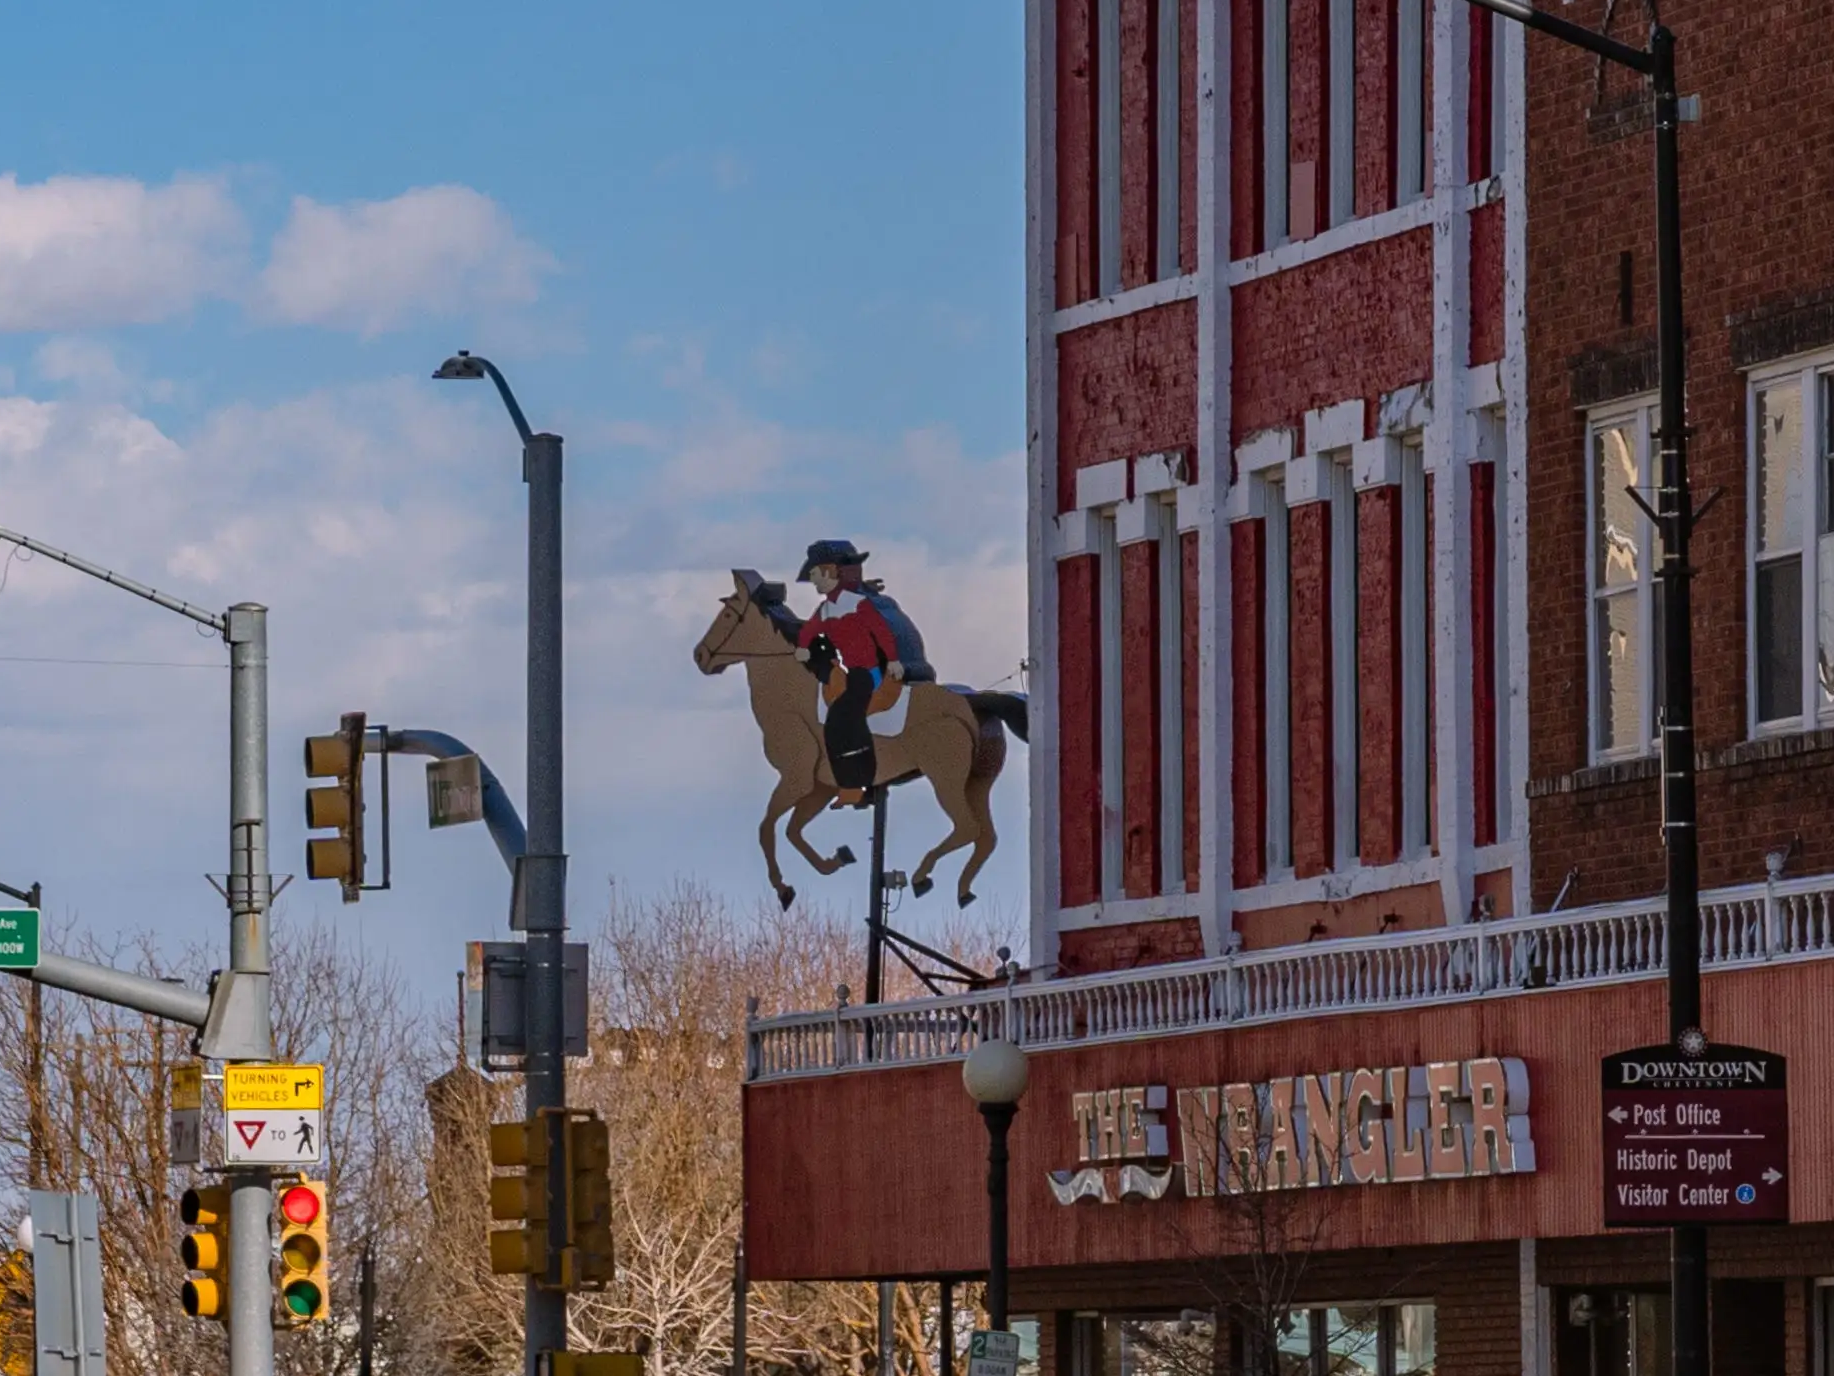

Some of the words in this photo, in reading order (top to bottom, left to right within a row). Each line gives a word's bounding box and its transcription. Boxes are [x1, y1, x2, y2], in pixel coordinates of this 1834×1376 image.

[232, 1072, 288, 1085] TURNING
[1620, 1060, 1768, 1084] DOWNTOWN
[1652, 1080, 1734, 1088] CHEYENNE
[230, 1090, 290, 1103] VEHICLES
[1633, 1103, 1668, 1126] Post
[1675, 1103, 1722, 1126] Office
[270, 1129, 287, 1141] TO
[1071, 1085, 1155, 1162] THE
[1175, 1056, 1521, 1198] WRANGLER
[1616, 1148, 1678, 1171] Historic
[1686, 1148, 1733, 1175] Depot
[1616, 1183, 1670, 1207] Visitor
[1678, 1183, 1730, 1206] Center
[973, 1335, 985, 1356] 2
